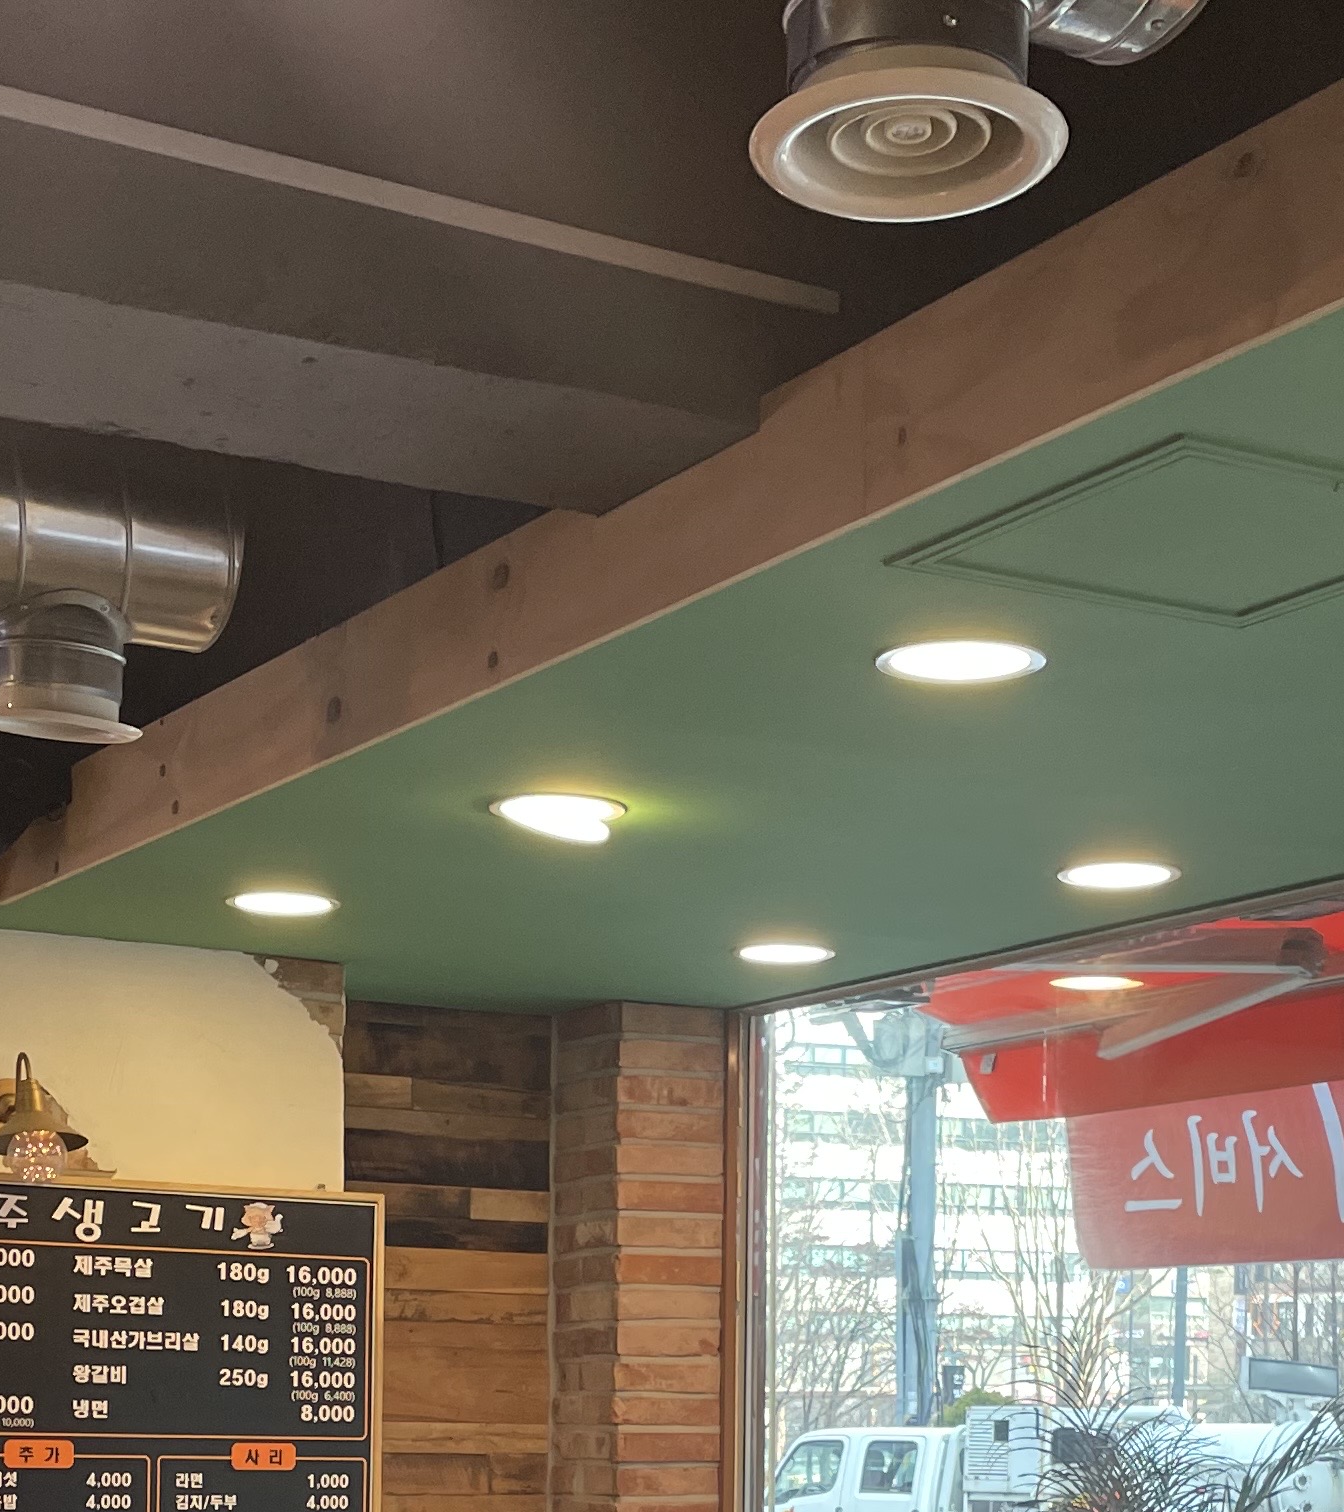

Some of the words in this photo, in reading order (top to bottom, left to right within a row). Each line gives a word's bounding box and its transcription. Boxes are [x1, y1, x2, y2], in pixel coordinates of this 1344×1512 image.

[72, 1254, 154, 1278] 제주목살
[217, 1261, 270, 1284] 180g
[286, 1265, 357, 1286] 16,000
[220, 1299, 270, 1320] 180g
[290, 1302, 357, 1322] 16,000
[72, 1328, 200, 1352] 국내산가브리살
[220, 1333, 269, 1354] 140g
[290, 1336, 356, 1356] 16,000
[72, 1364, 127, 1385] 왕갈비
[219, 1368, 269, 1389] 250g
[289, 1370, 356, 1390] 16,000
[72, 1398, 109, 1419] 냉면
[300, 1404, 355, 1424] 8,000
[85, 1472, 132, 1489] 4,000
[175, 1472, 203, 1489] 라면
[307, 1473, 349, 1490] 1,000
[85, 1493, 132, 1511] 4,000
[306, 1494, 349, 1511] 4,000
